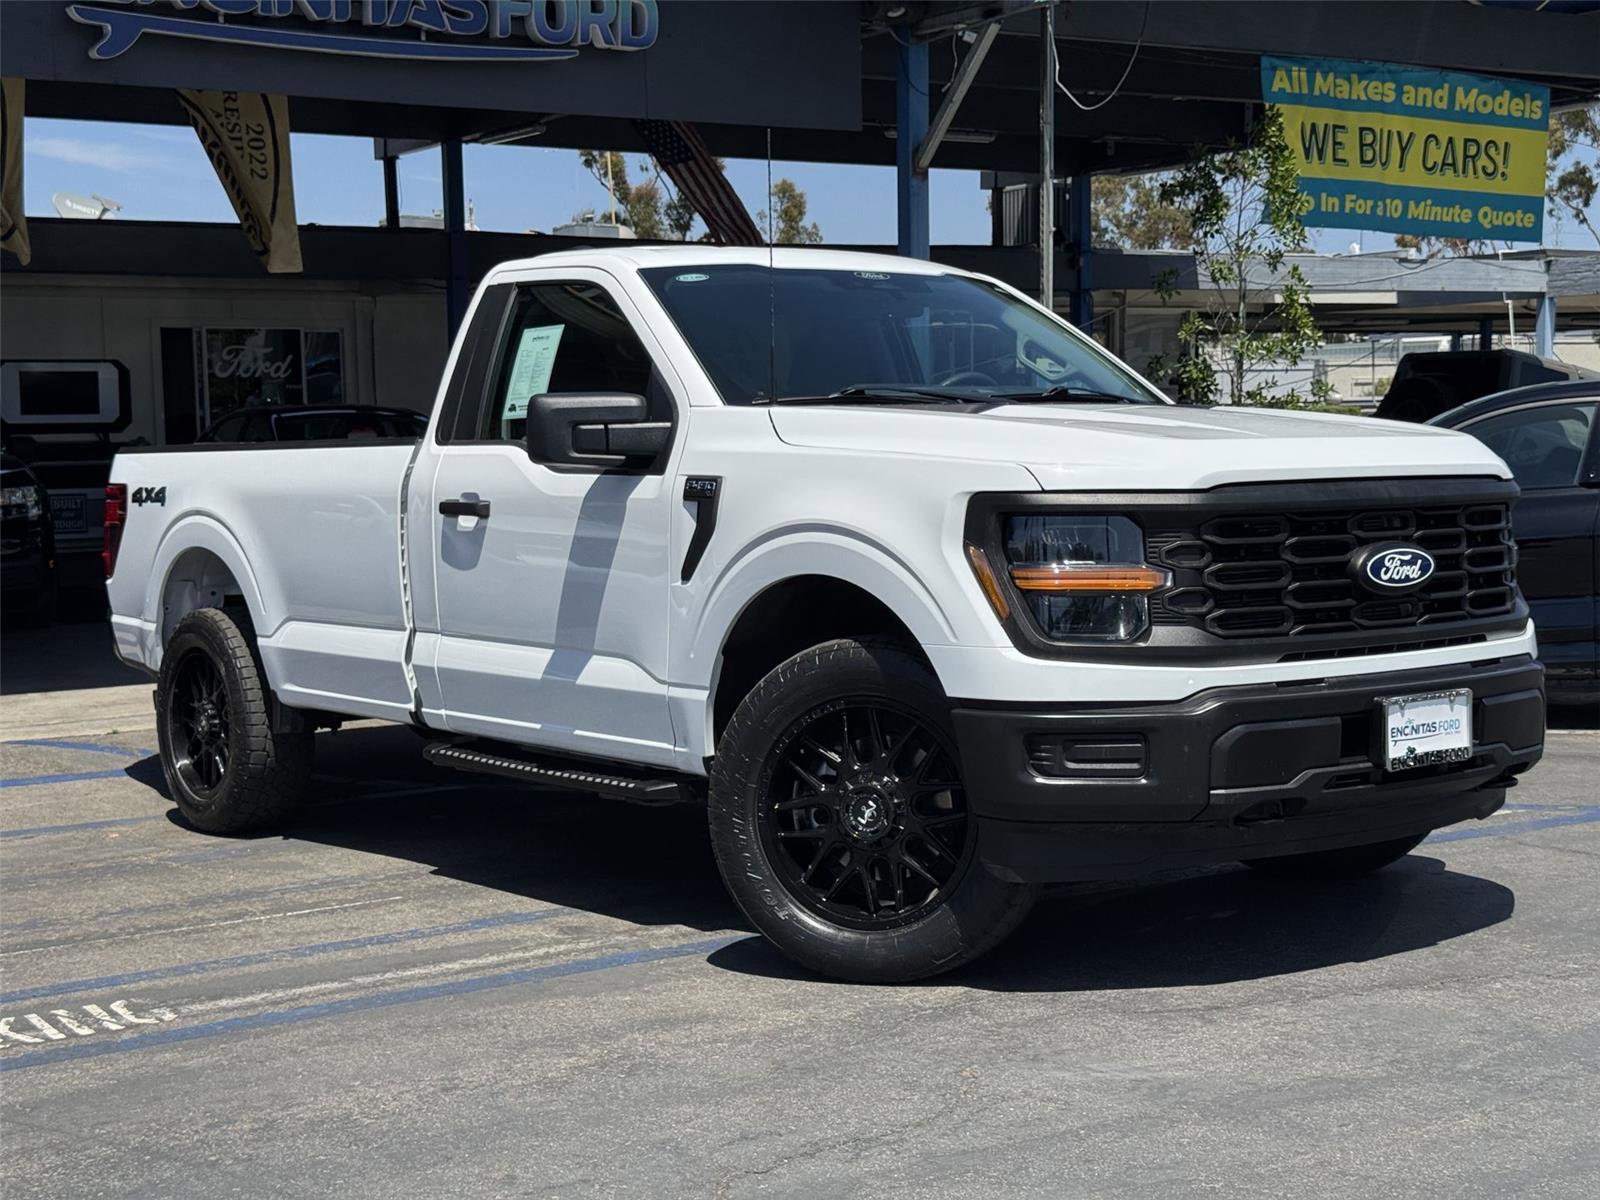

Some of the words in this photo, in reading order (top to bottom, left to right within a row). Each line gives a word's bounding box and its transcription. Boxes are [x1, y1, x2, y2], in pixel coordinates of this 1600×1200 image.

[494, 0, 659, 50] FORD
[1271, 66, 1309, 95] All
[1313, 71, 1396, 103] Makes
[1402, 83, 1449, 110] and
[1454, 86, 1543, 120] Models
[246, 123, 268, 181] 2022
[1300, 121, 1350, 167] WE
[1358, 126, 1417, 173] BUY
[1421, 133, 1511, 182] CARS!
[1320, 192, 1340, 213] In
[1344, 194, 1374, 215] For
[1408, 200, 1472, 224] Minute
[1477, 205, 1536, 230] Quote
[214, 345, 293, 378] Ford
[1380, 554, 1422, 580] Ford
[1391, 720, 1437, 739] ENCNITAS
[1439, 718, 1460, 733] FORD
